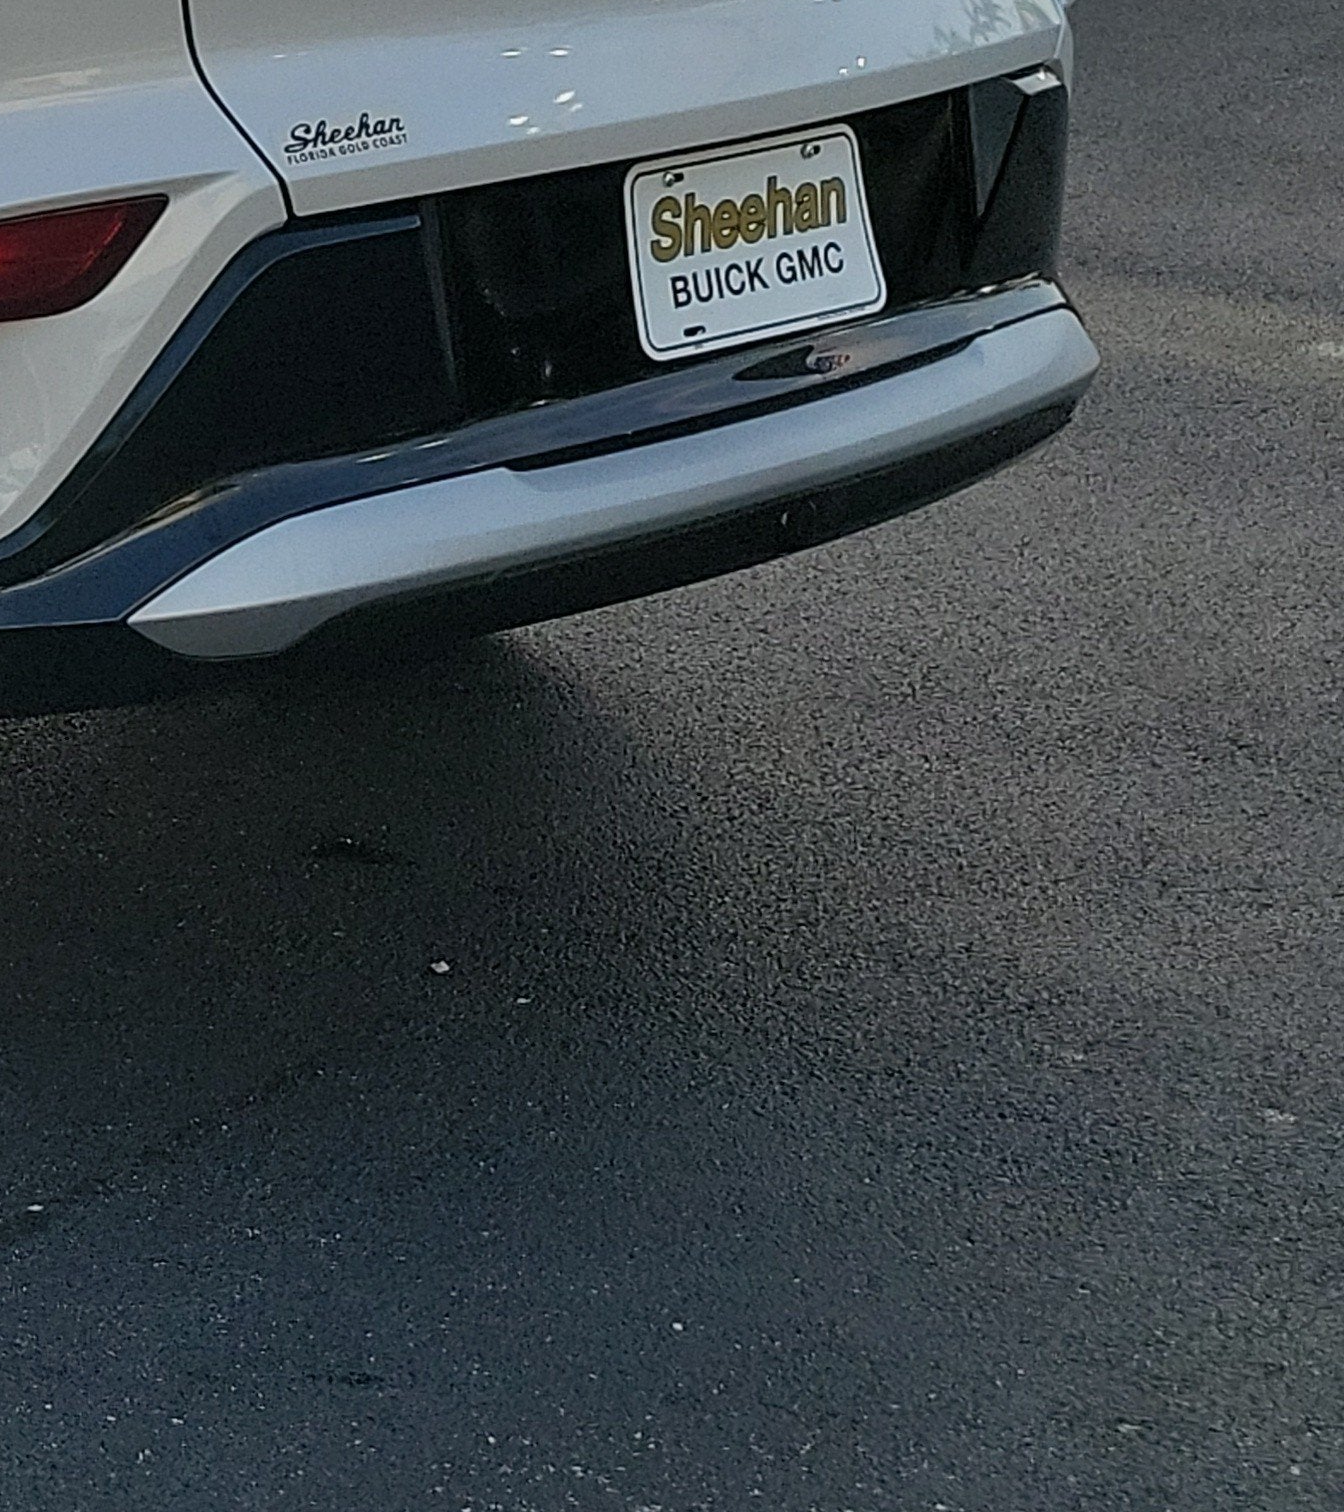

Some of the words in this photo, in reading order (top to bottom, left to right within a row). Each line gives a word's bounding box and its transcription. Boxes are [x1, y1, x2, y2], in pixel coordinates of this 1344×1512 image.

[284, 112, 405, 154] Sheehan
[287, 148, 337, 166] FLORIDA
[338, 141, 370, 155] GOLD
[372, 133, 408, 148] COAST
[650, 175, 847, 263] Sheehan
[669, 257, 770, 309] BUICK
[775, 241, 844, 285] GMC
